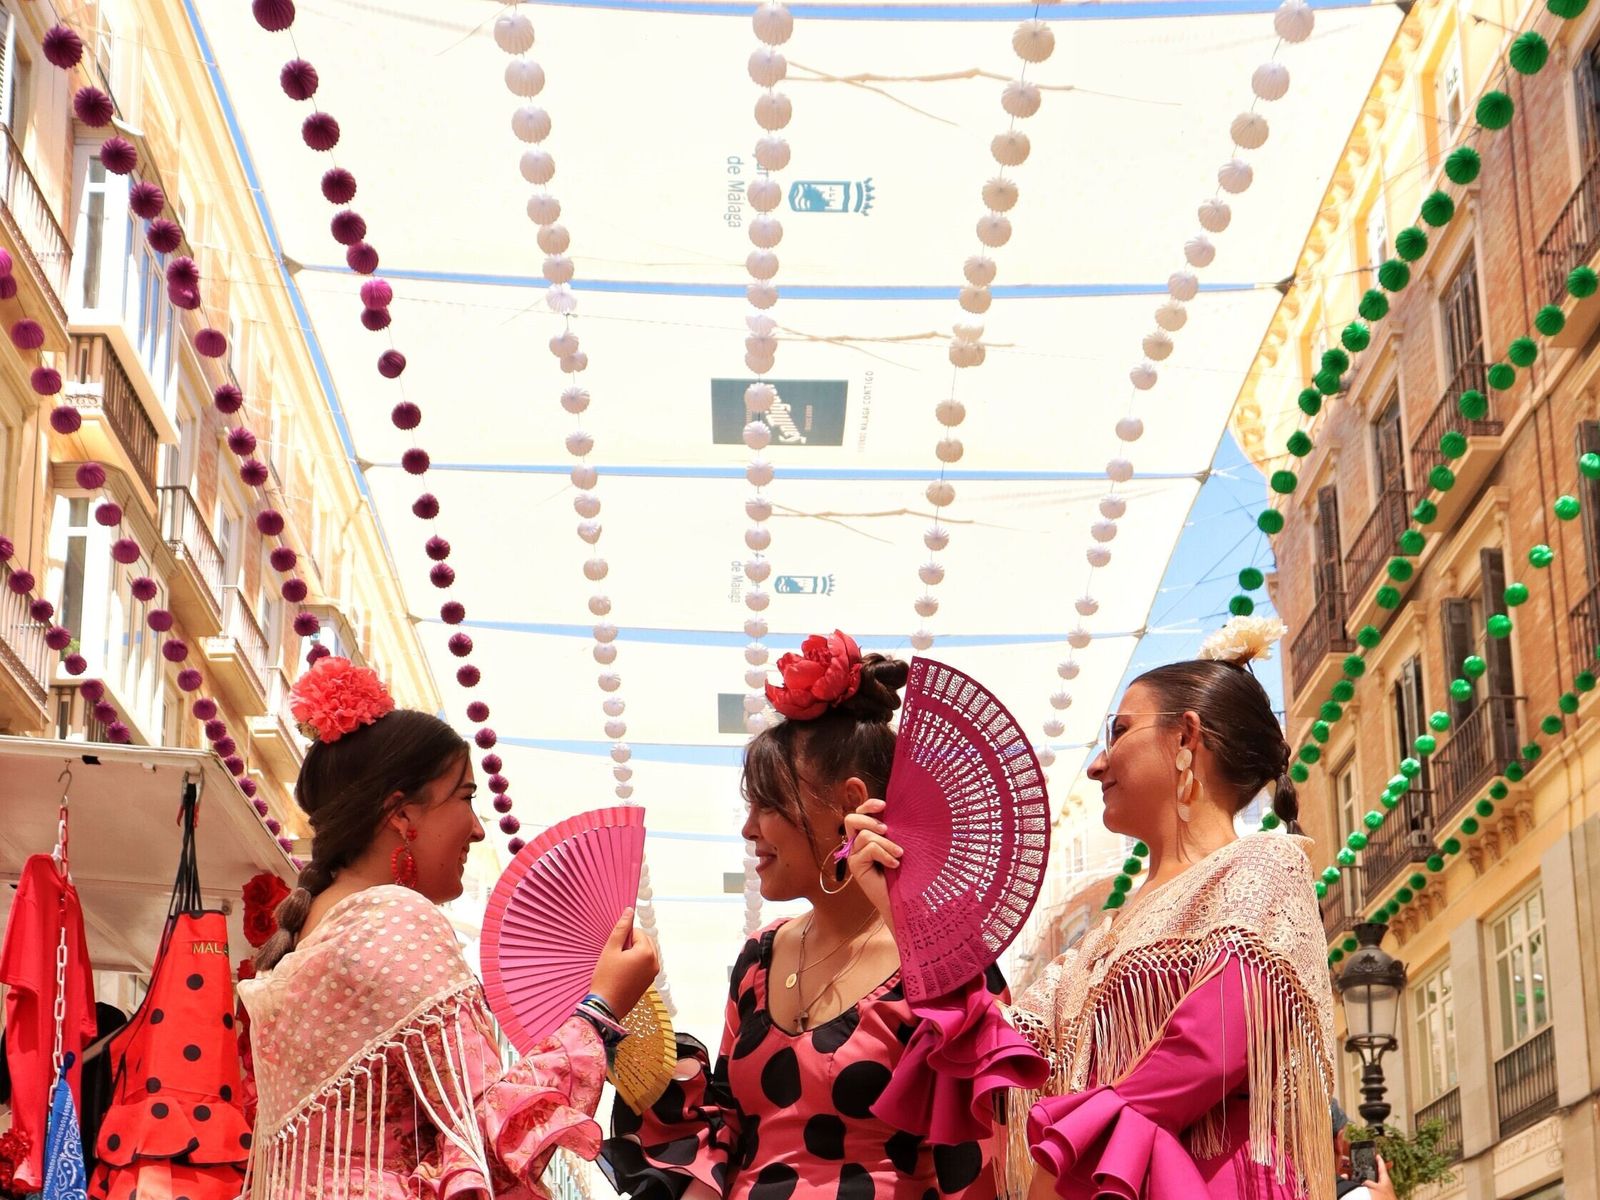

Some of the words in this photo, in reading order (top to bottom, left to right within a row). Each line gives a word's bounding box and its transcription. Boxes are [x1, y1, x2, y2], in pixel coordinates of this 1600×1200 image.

[727, 155, 744, 175] de
[723, 180, 746, 228] Málaga
[193, 941, 229, 955] MAL
